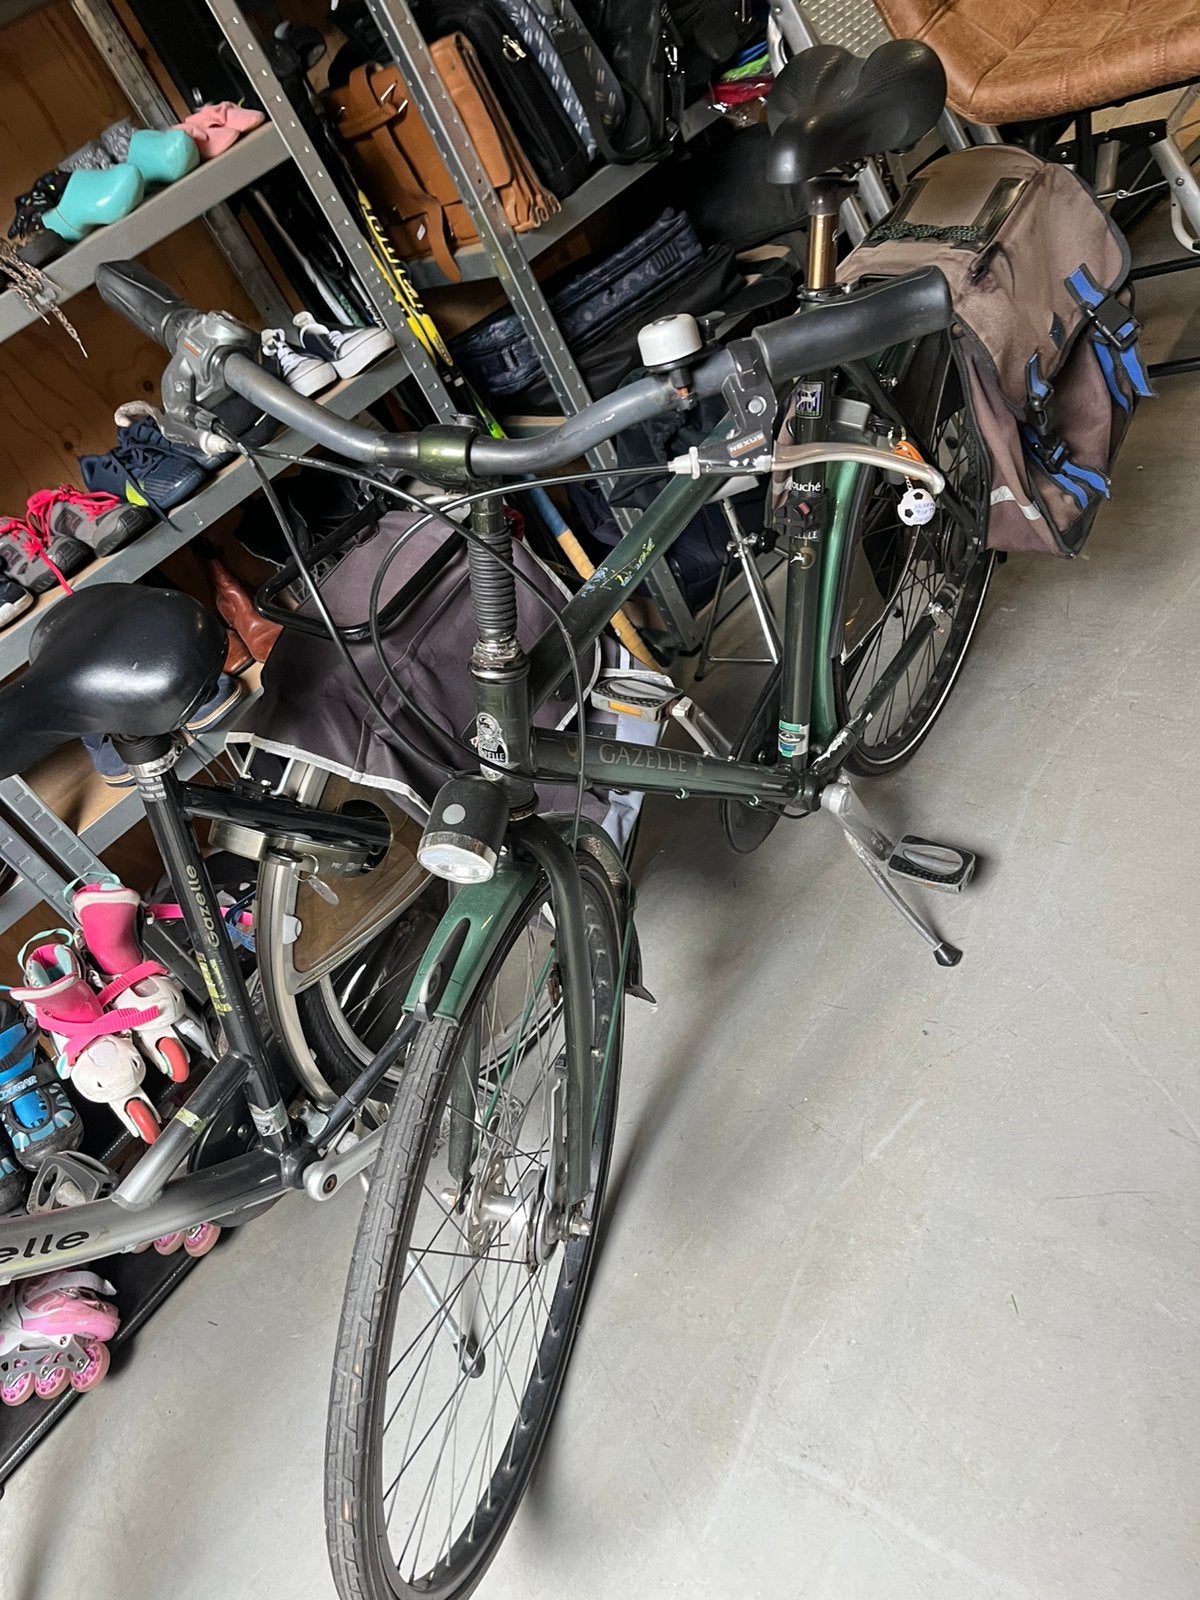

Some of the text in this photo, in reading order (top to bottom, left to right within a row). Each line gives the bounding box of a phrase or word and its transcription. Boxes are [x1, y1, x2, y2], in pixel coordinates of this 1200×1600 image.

[729, 433, 765, 453] NEXUS
[791, 481, 821, 492] ouché
[599, 743, 688, 773] GAZELLE
[186, 864, 220, 948] Gazelle
